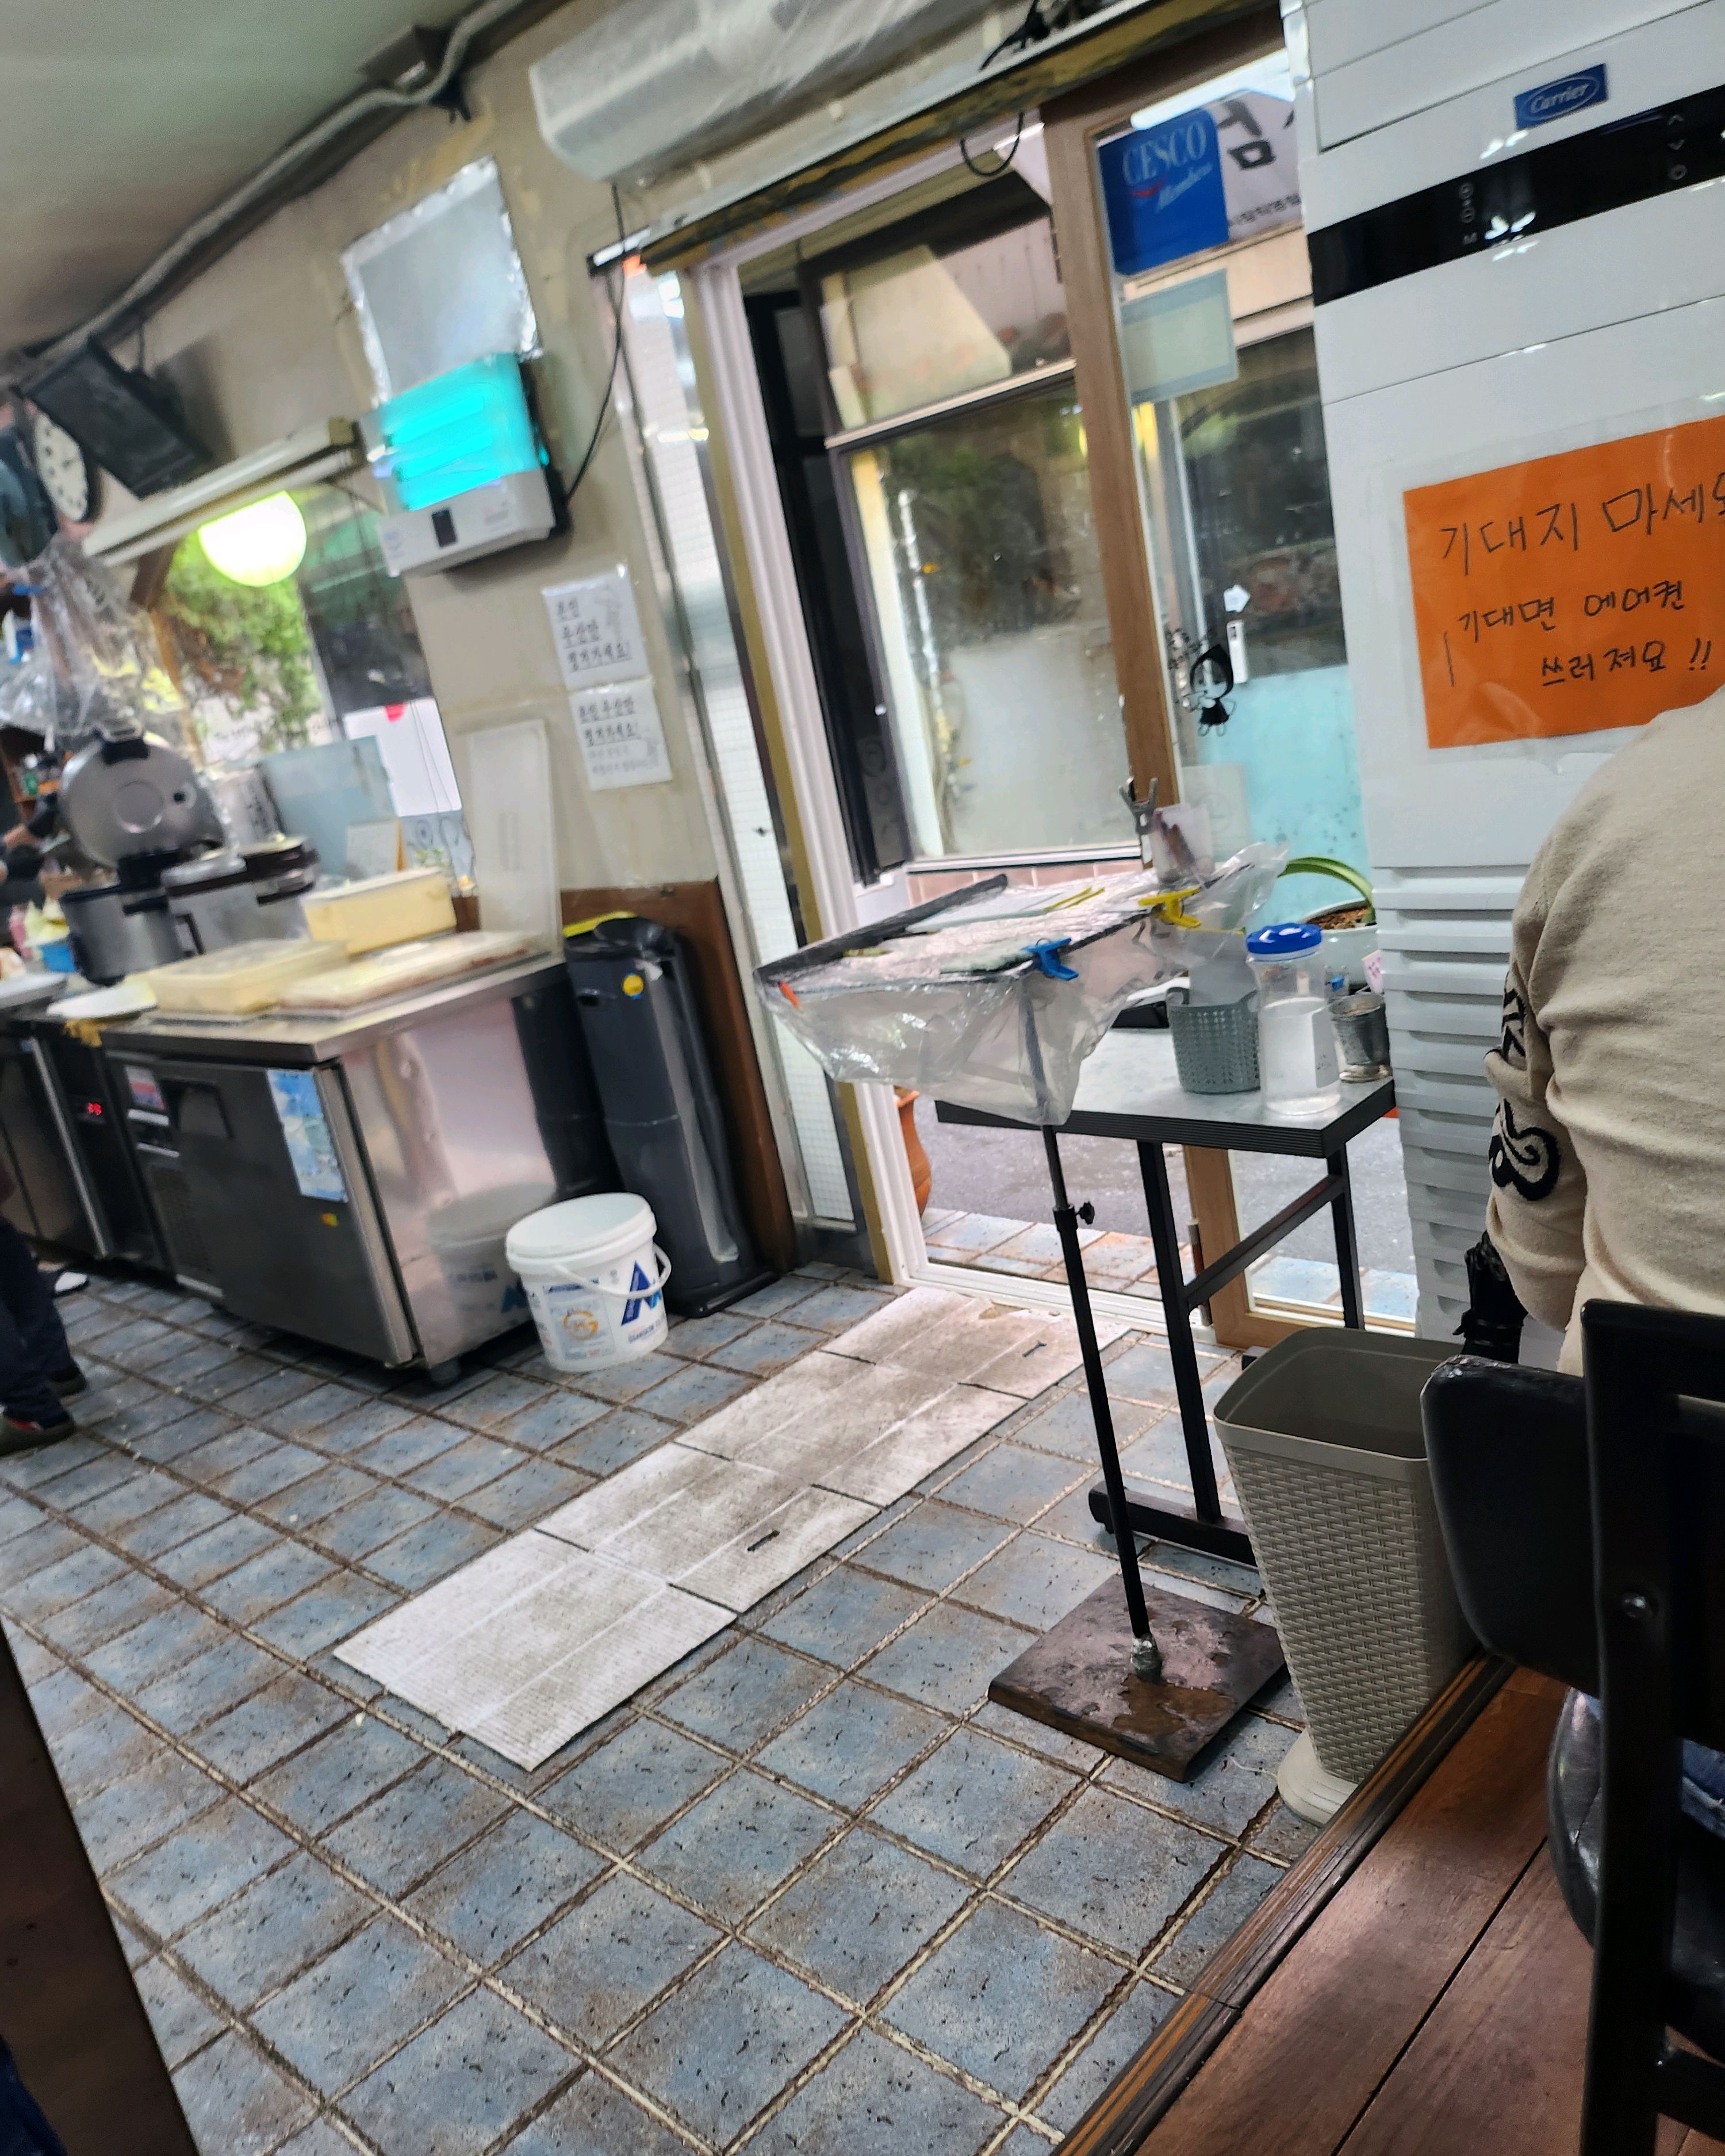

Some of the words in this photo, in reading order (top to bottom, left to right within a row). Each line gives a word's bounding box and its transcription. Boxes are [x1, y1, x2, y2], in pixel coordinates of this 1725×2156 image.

[1530, 83, 1590, 113] Carrier
[1122, 120, 1207, 187] CESCO
[1440, 502, 1579, 576] 기대지
[1456, 596, 1556, 644] 기대면
